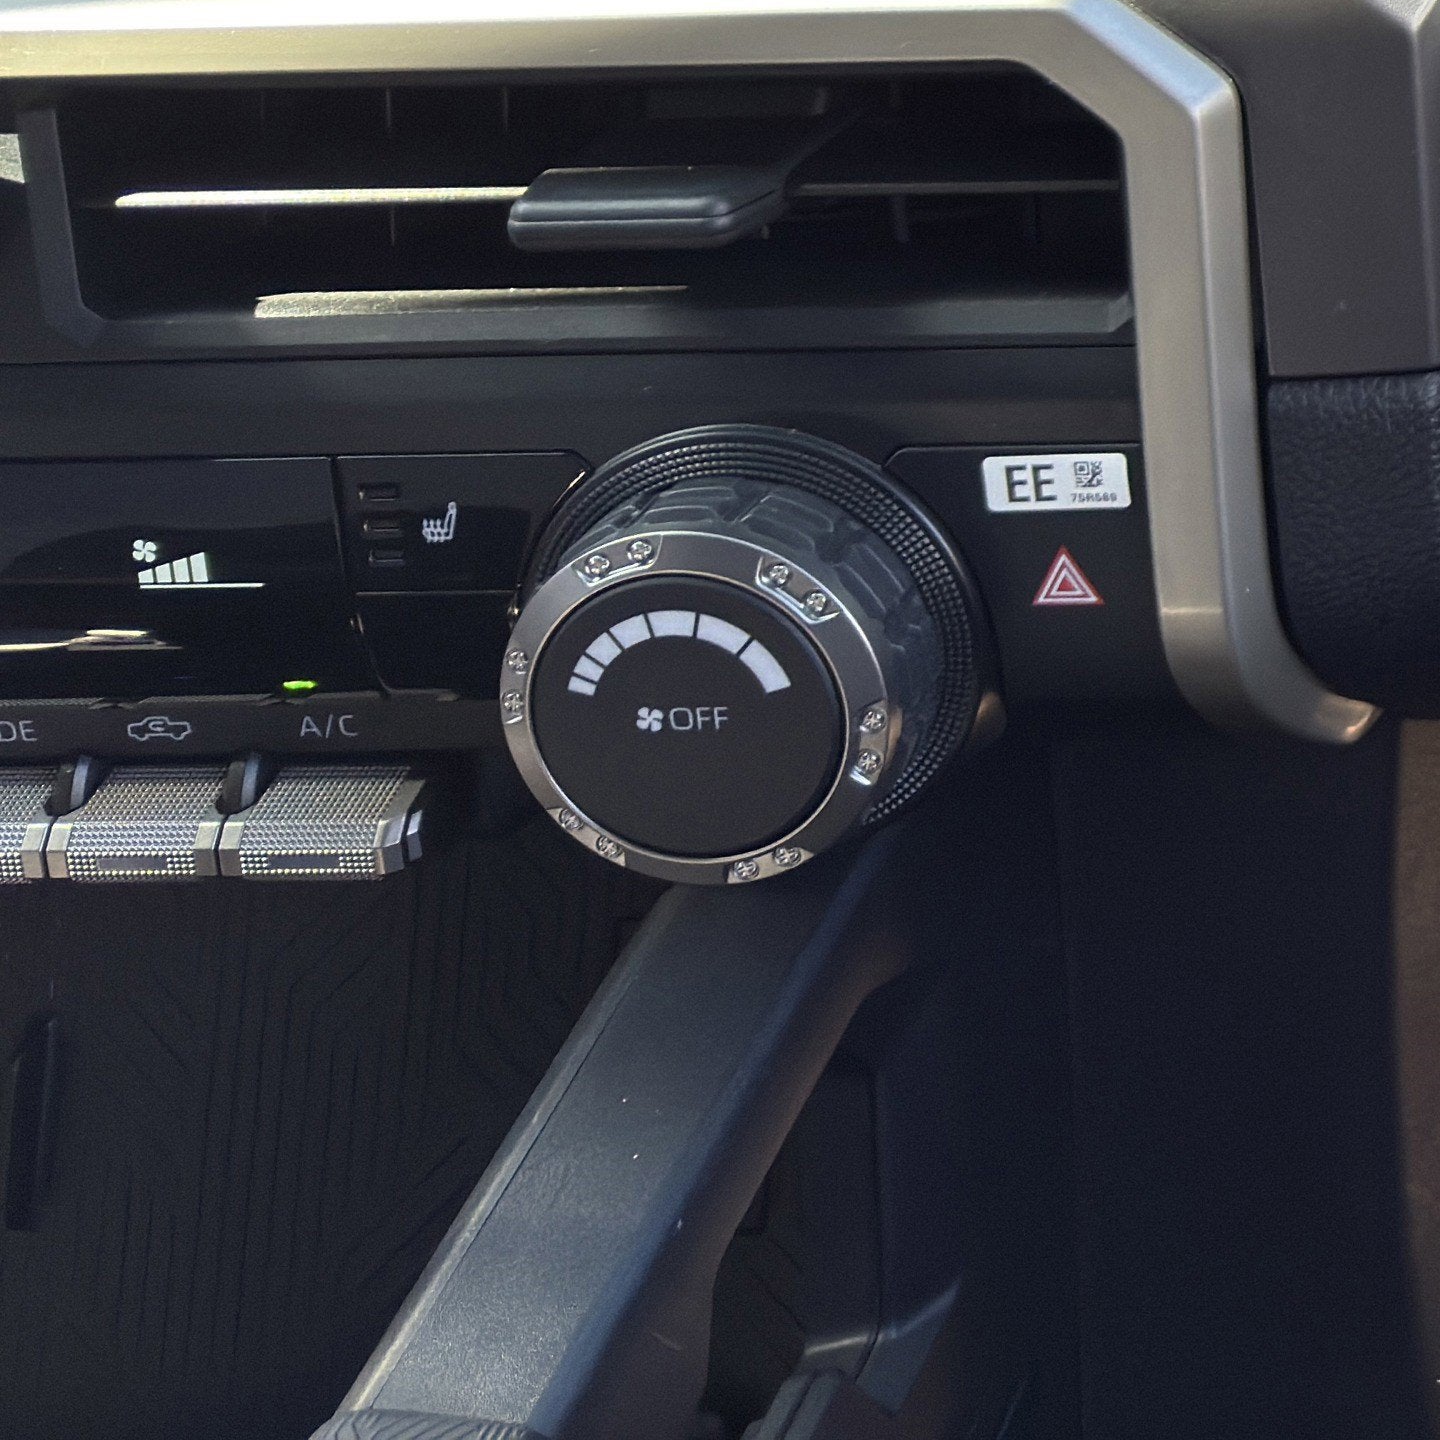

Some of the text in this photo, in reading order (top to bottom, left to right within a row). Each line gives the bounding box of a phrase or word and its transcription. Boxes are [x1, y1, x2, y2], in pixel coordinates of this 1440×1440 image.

[1004, 463, 1058, 503] EE
[300, 714, 358, 740] A/C
[669, 706, 729, 731] OFF
